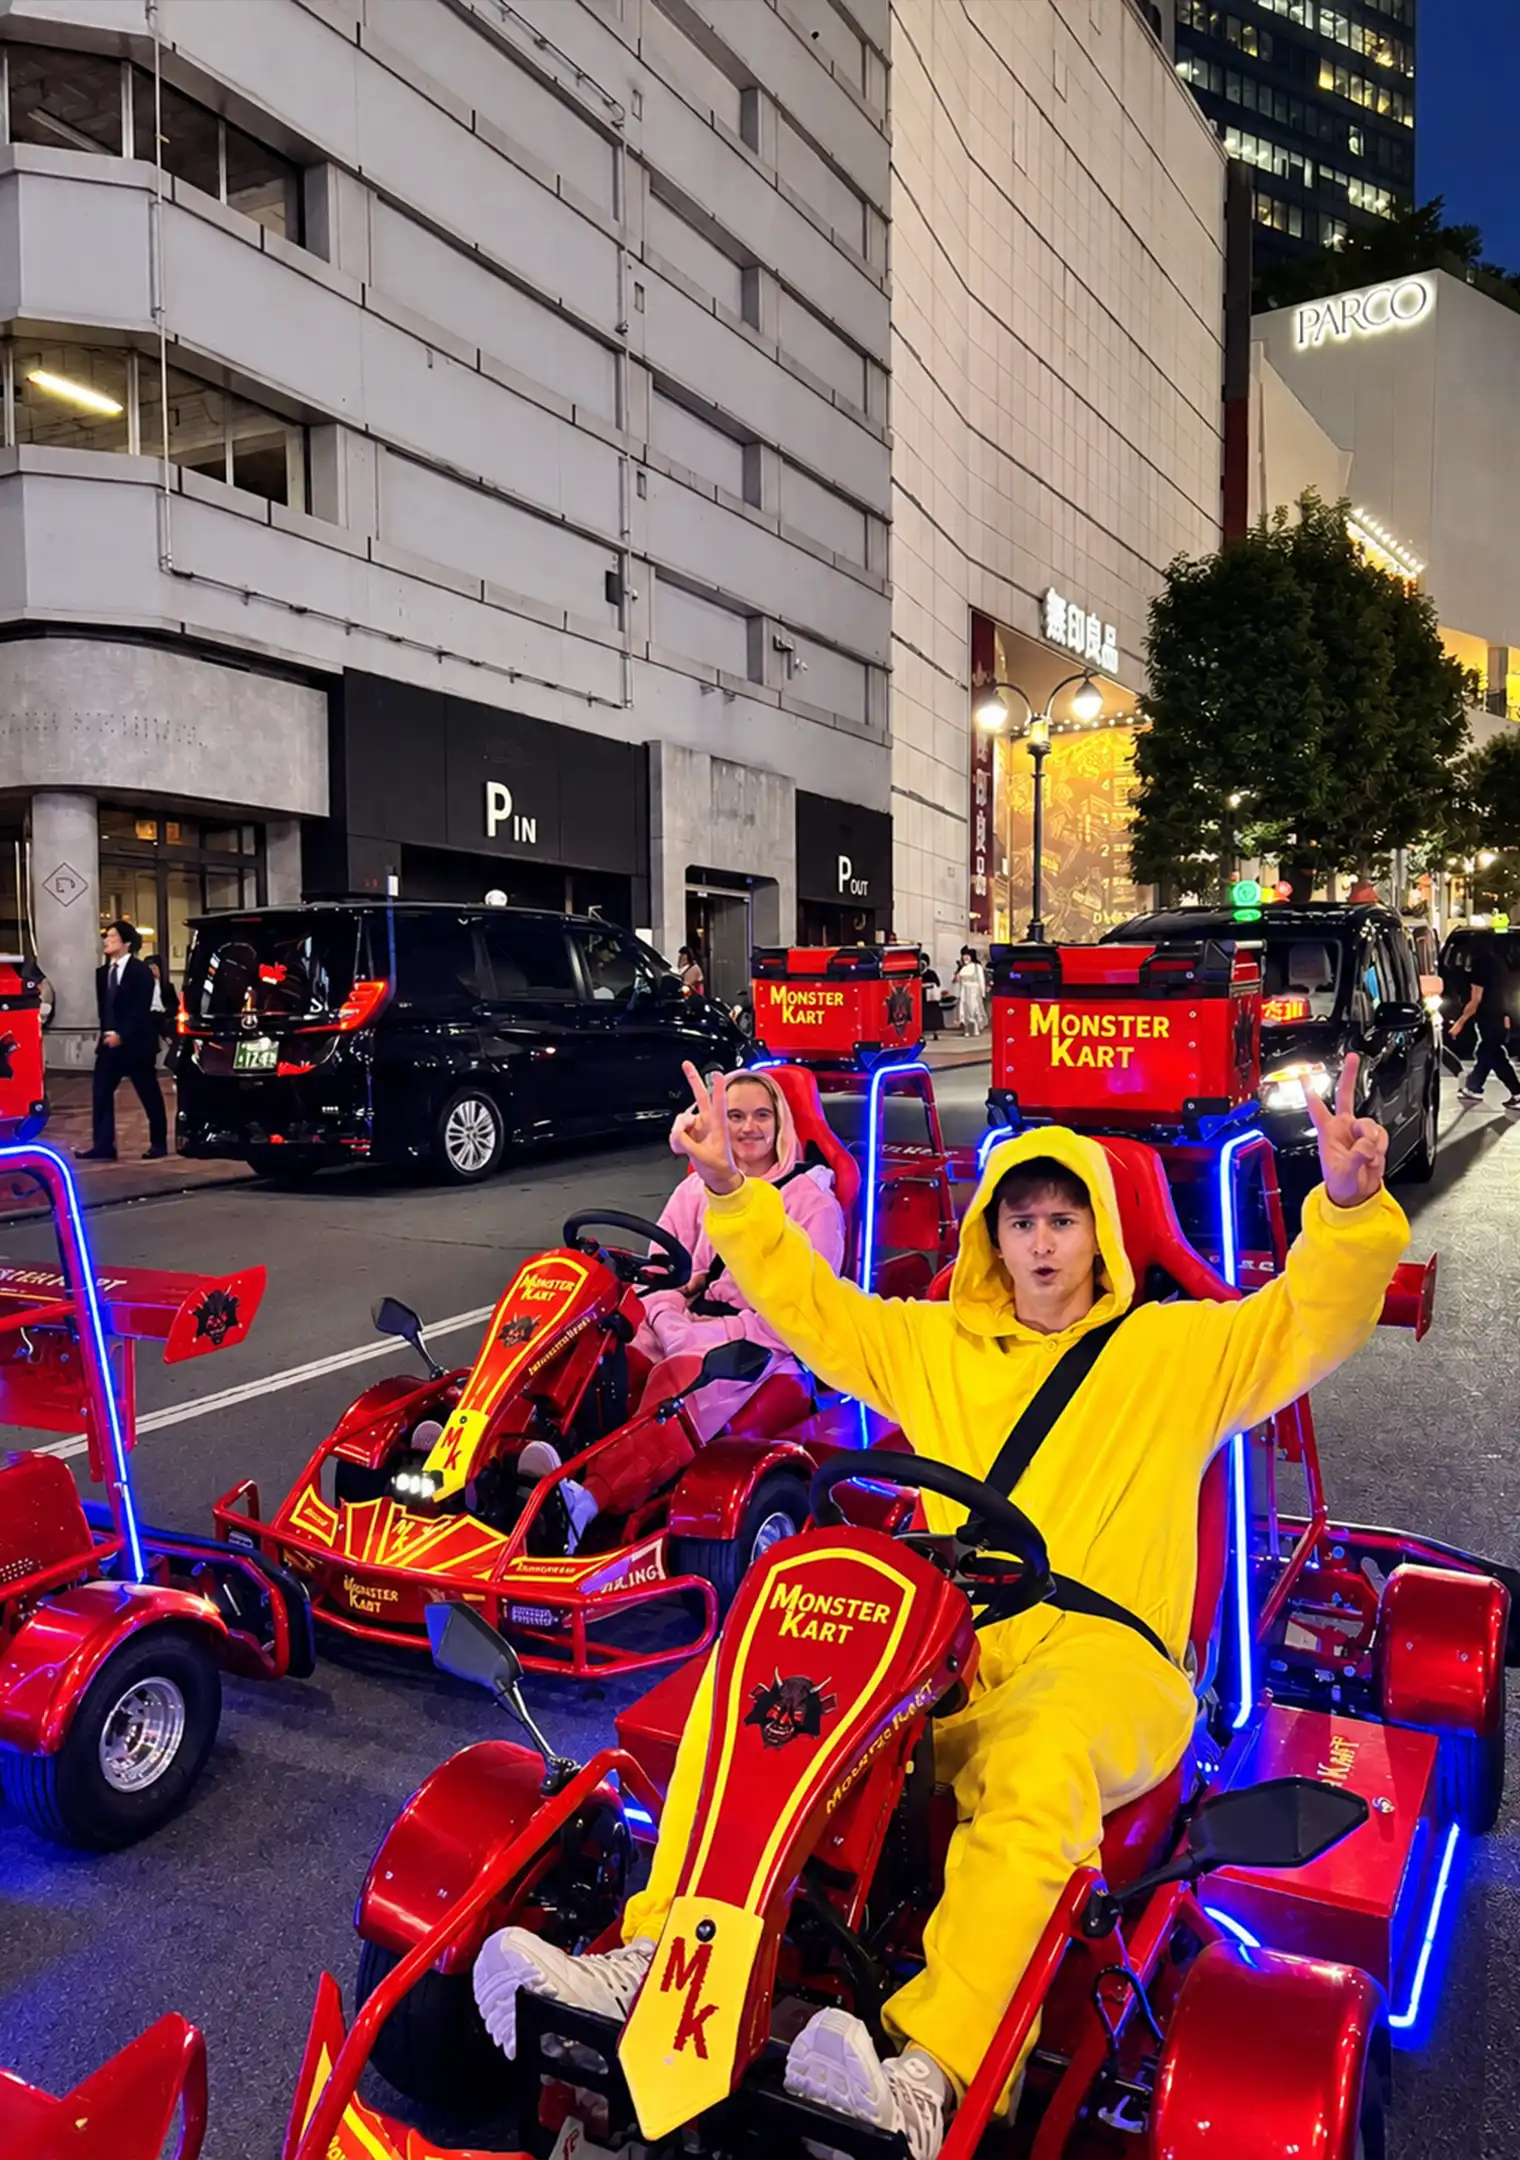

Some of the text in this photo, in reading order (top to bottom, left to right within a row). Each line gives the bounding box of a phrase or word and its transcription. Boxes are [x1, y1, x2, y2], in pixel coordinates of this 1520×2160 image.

[1298, 281, 1428, 344] PARCO
[770, 985, 844, 1006] MONSTER
[782, 1001, 825, 1025] KART
[1030, 1003, 1170, 1039] MONSTER
[1051, 1035, 1135, 1069] KART
[769, 1582, 891, 1624] MONSTER
[778, 1610, 854, 1644] KART
